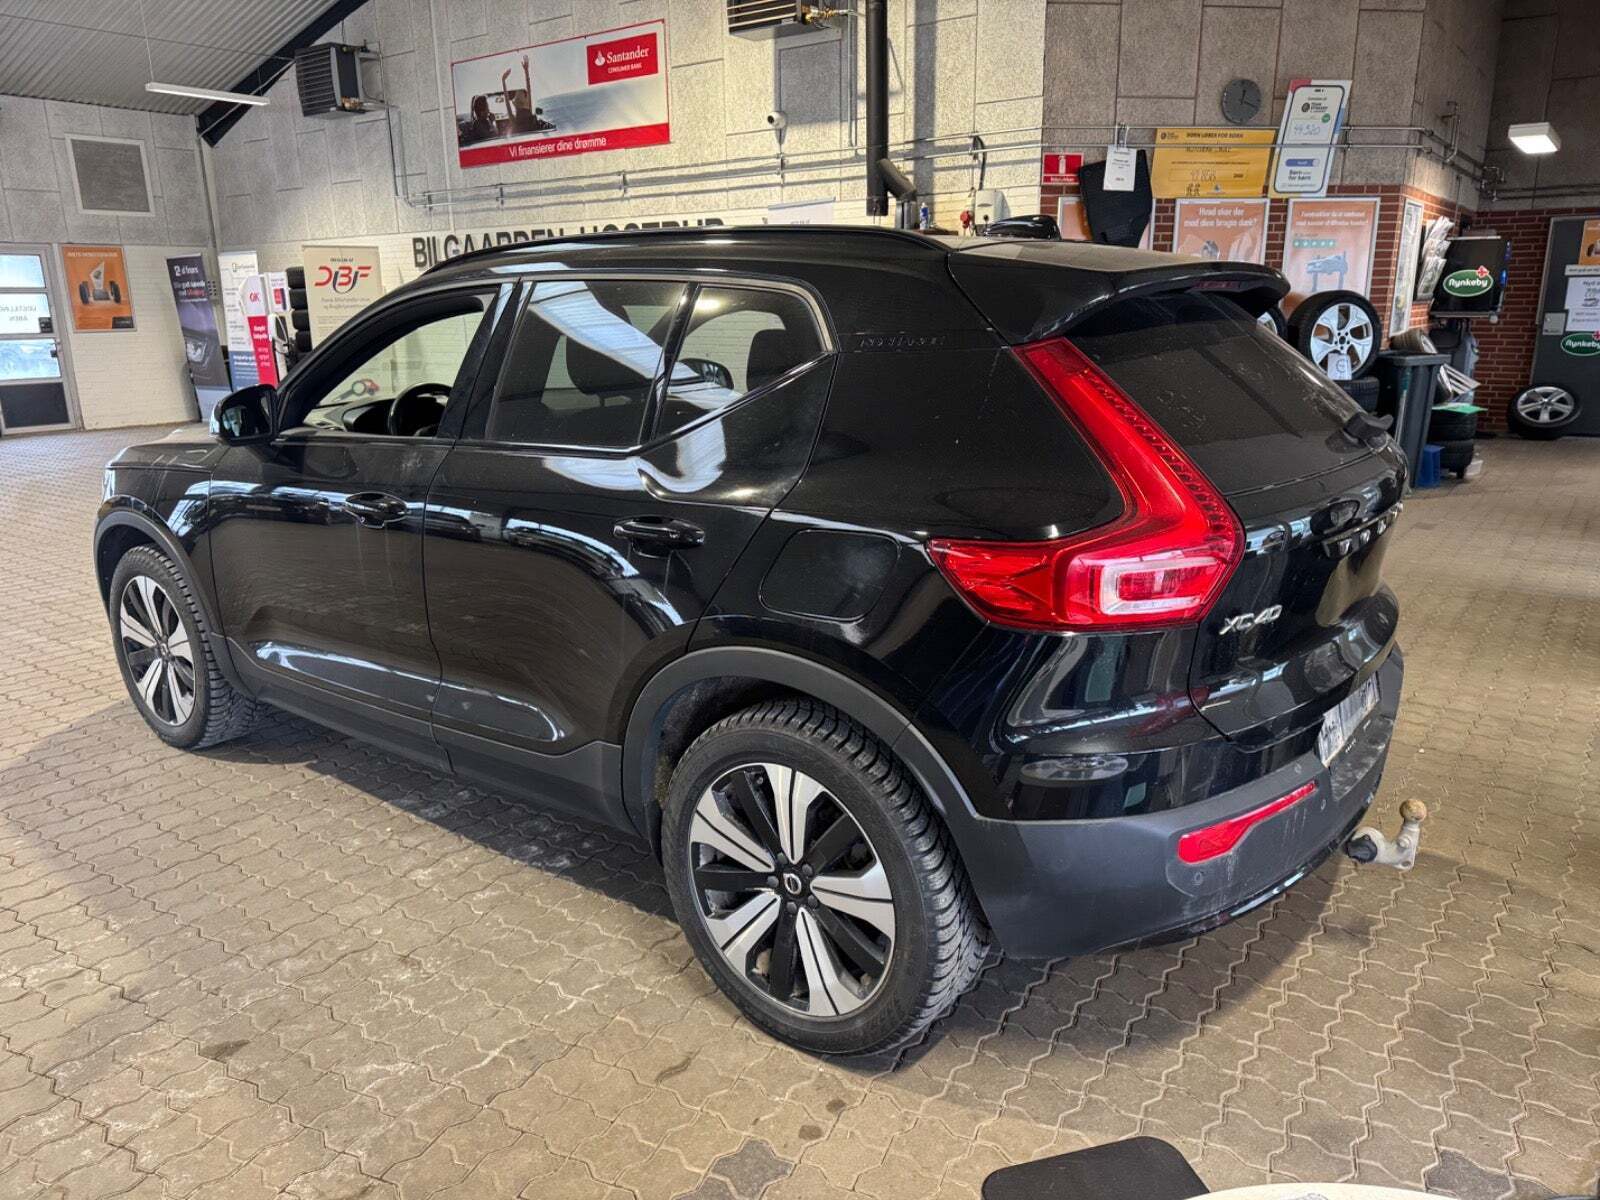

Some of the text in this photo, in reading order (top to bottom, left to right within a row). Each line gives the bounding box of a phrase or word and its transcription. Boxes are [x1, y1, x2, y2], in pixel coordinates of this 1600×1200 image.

[607, 45, 650, 64] Santander
[608, 62, 643, 74] CONSUMER BANK
[509, 136, 607, 158] Vi finansierer dine drømme
[1448, 278, 1488, 289] Rynkeby
[1219, 604, 1283, 635] XC40
